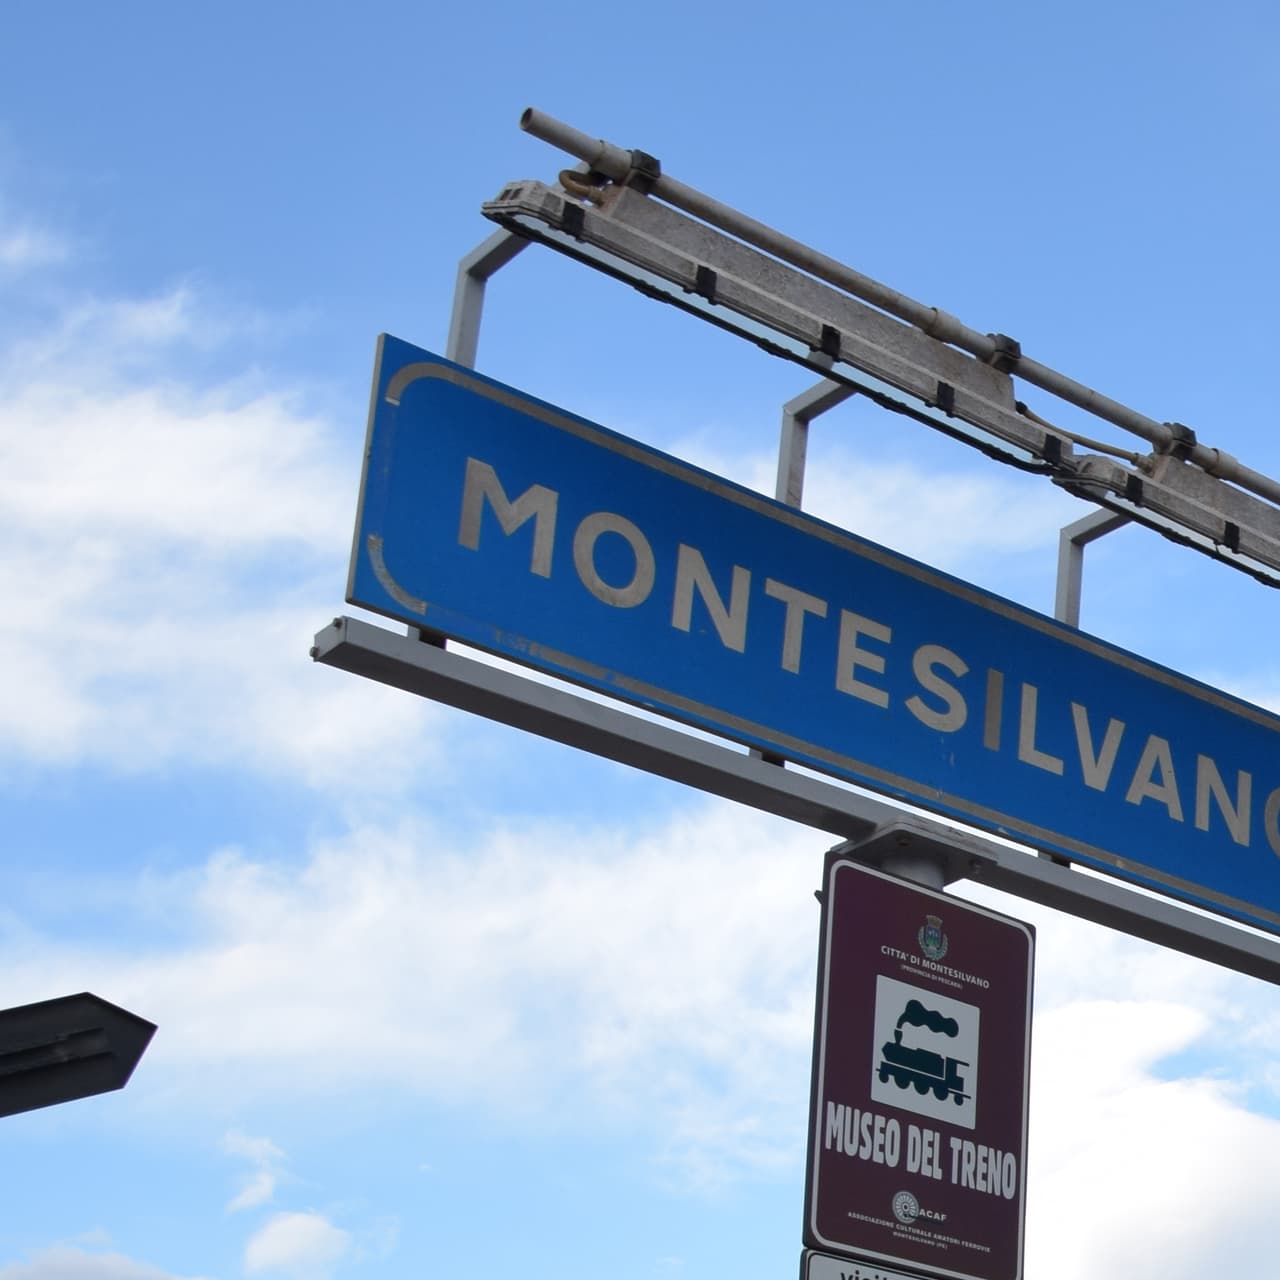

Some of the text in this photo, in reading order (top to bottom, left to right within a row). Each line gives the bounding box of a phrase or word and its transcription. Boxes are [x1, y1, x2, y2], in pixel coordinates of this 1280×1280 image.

[910, 955, 920, 966] DI
[922, 959, 990, 989] MONTESILVANO
[825, 1100, 1017, 1200] MUSEO DEL TRENO
[847, 1211, 895, 1229] ASSOCIAZIONE
[896, 1223, 932, 1238] CULTURALE
[961, 1240, 991, 1253] FERROVIE
[919, 1208, 948, 1222] ACAF
